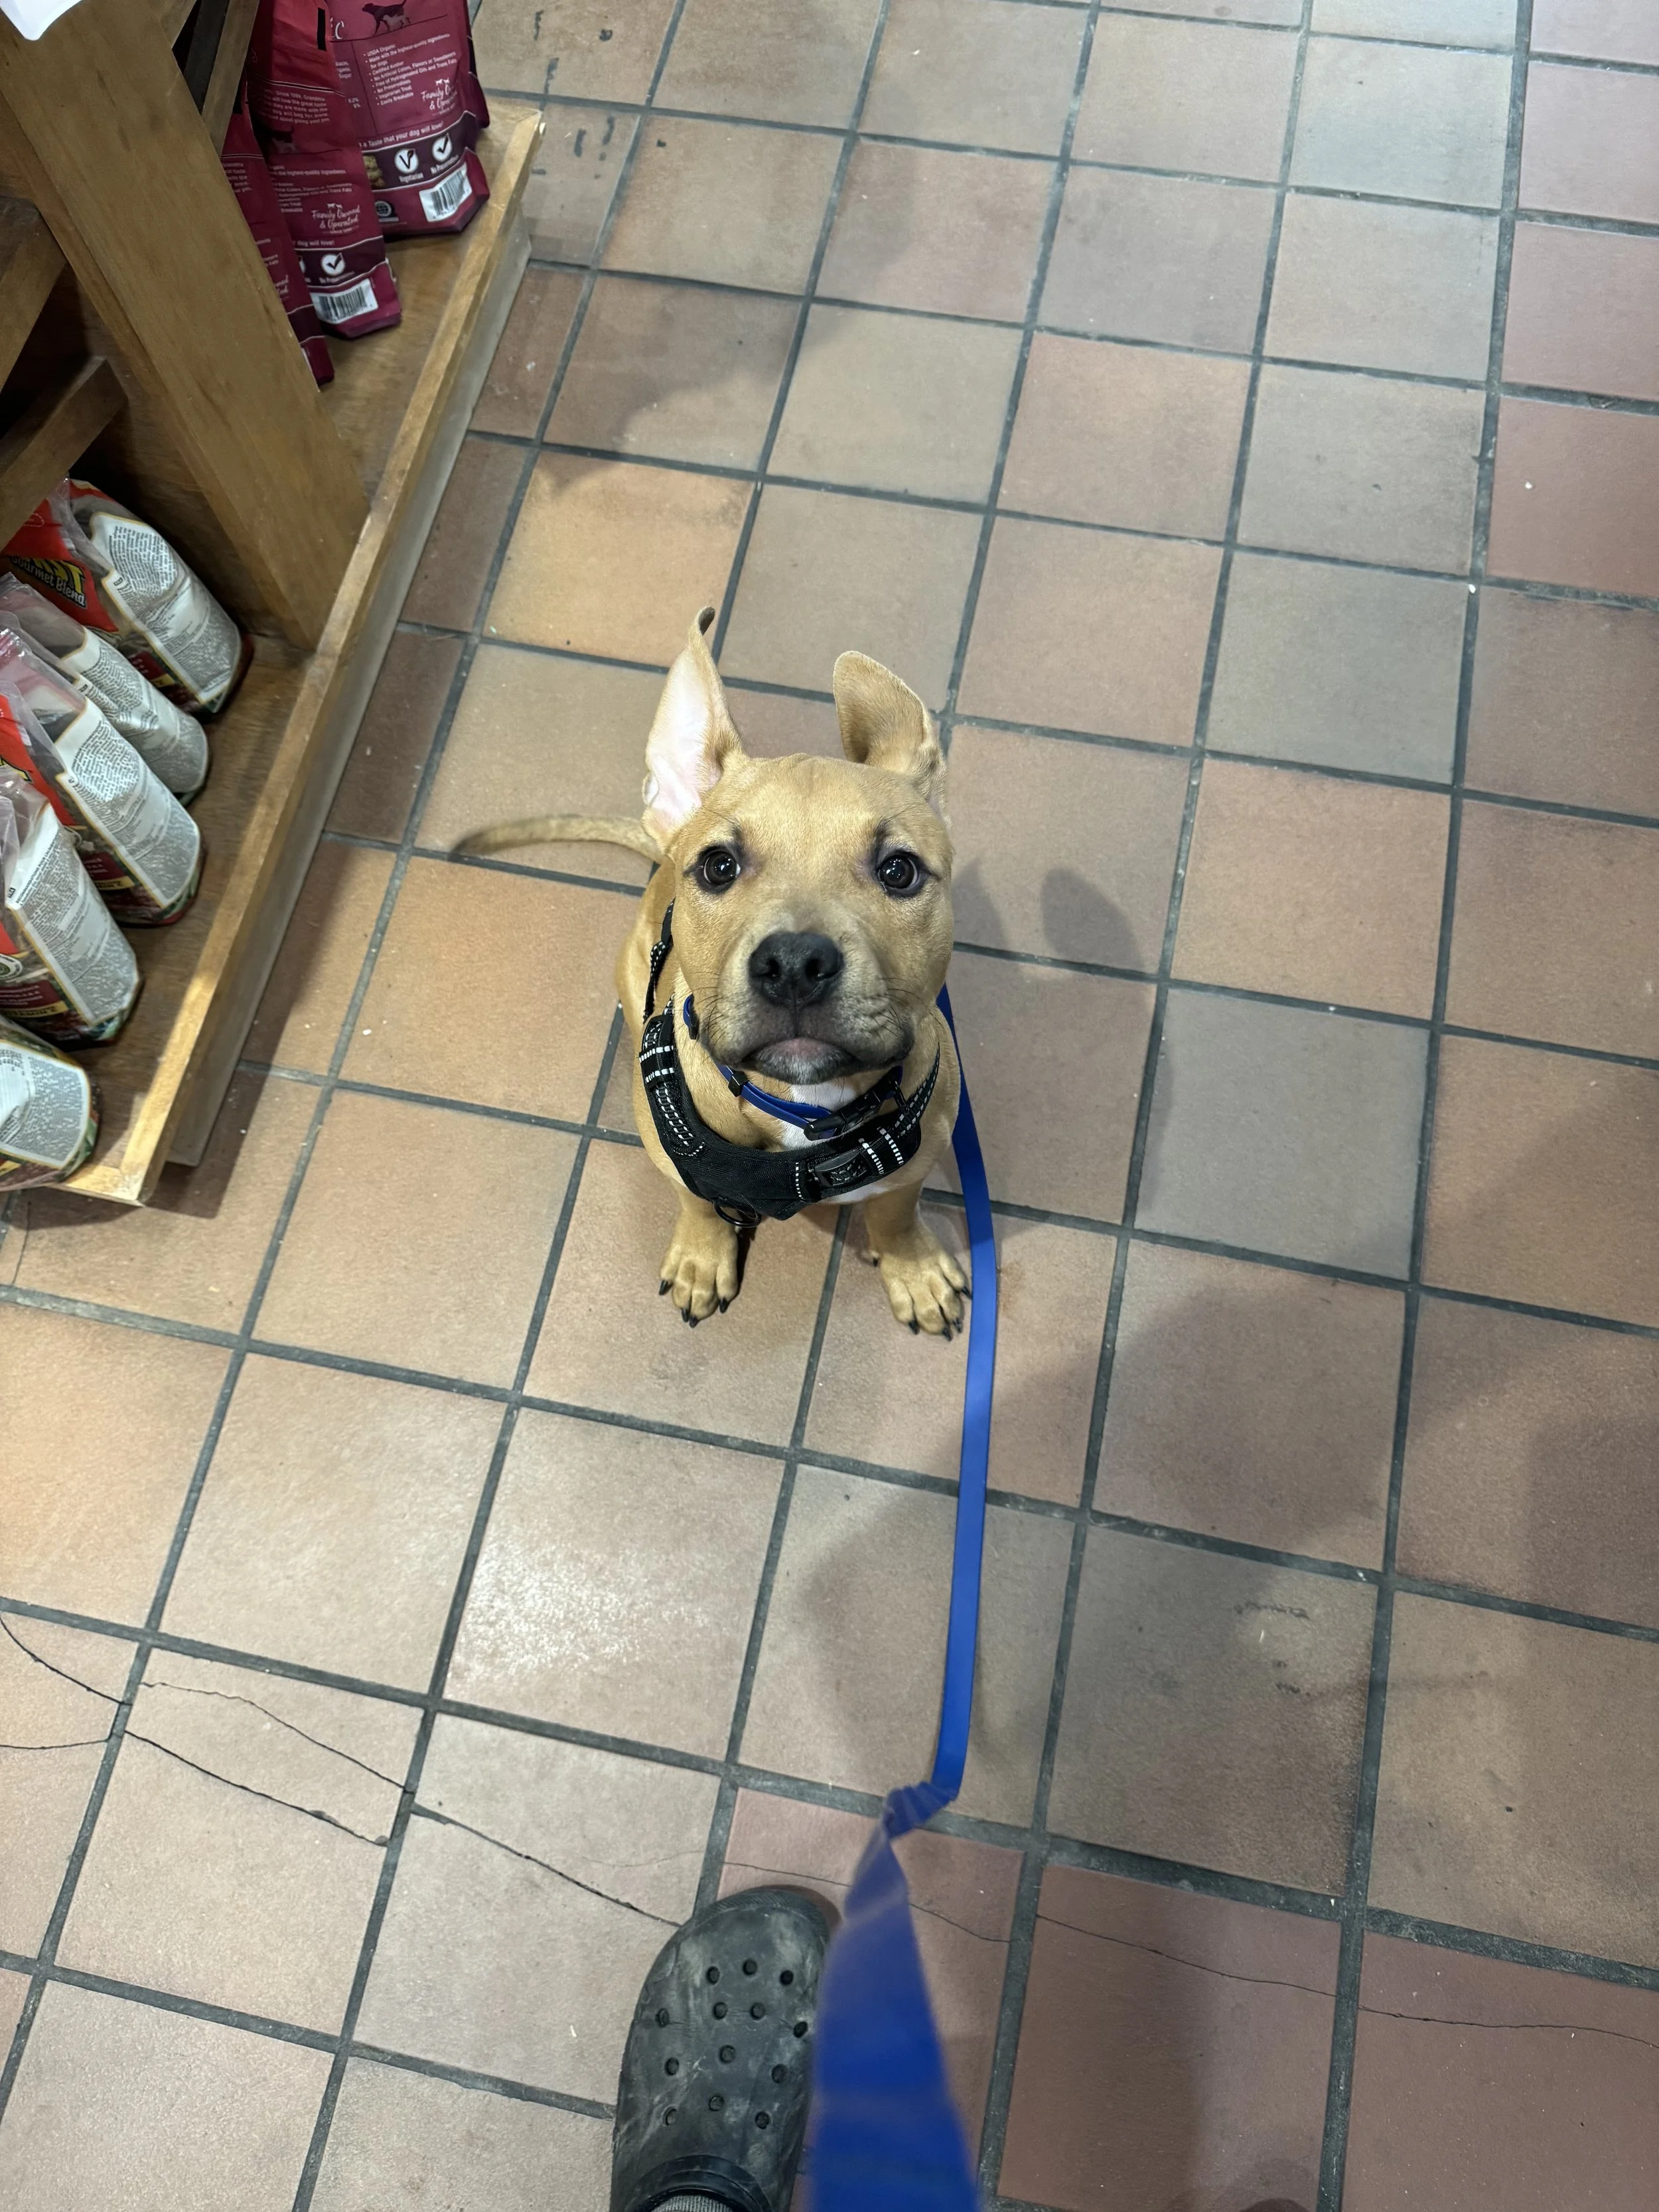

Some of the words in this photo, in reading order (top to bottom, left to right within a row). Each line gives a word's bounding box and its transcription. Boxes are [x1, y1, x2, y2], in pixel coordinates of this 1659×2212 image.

[421, 87, 444, 102] Family
[429, 100, 435, 110] &
[396, 131, 408, 141] your
[409, 129, 420, 137] dog
[311, 209, 336, 221] Family
[336, 204, 361, 219] Owned
[327, 214, 359, 230] Operated
[55, 577, 86, 607] Blend
